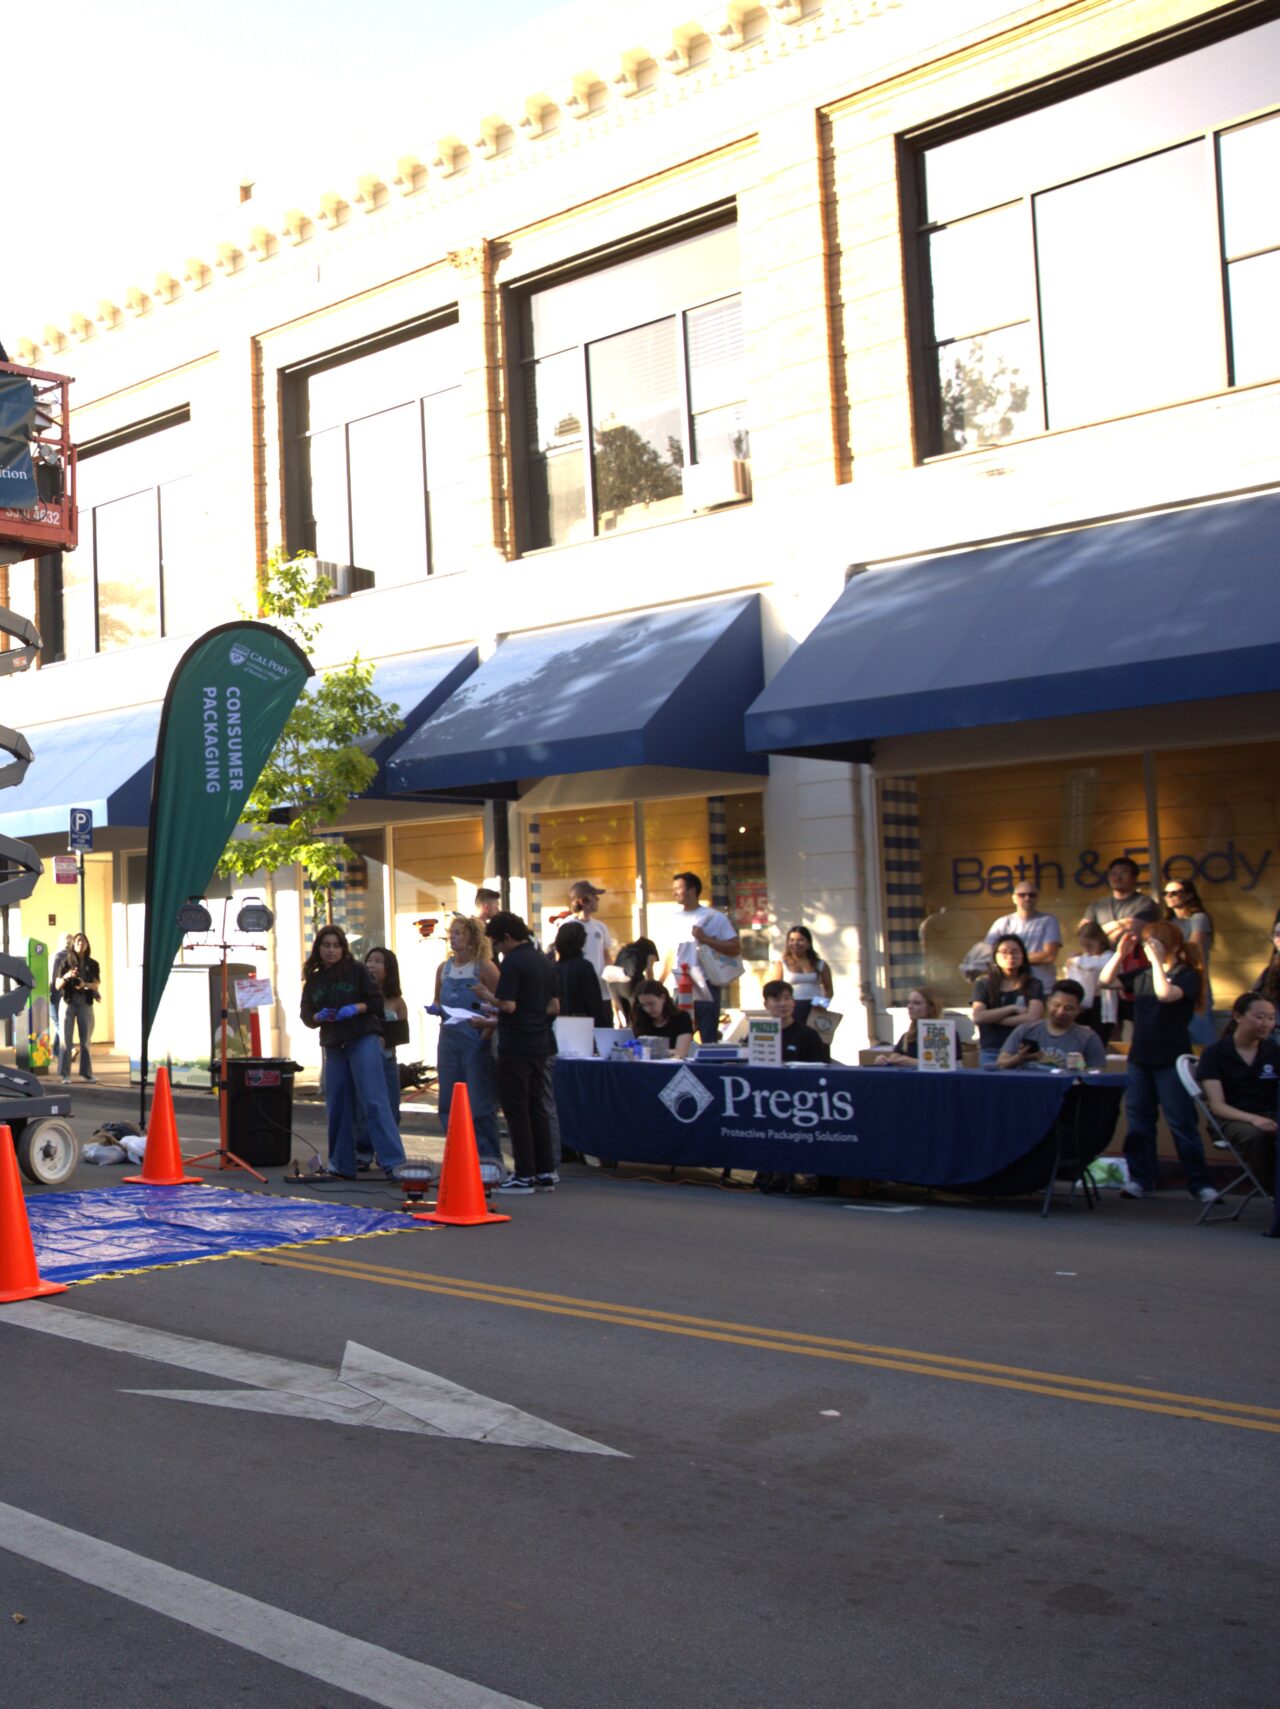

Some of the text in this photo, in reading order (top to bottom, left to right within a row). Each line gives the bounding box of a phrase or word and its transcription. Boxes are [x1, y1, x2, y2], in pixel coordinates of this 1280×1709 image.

[250, 651, 291, 676] CAL POLY
[203, 686, 220, 793] PACKAGING
[226, 686, 244, 791] CONSUMER
[75, 813, 87, 831] P
[951, 853, 1065, 896] Bath
[1073, 849, 1112, 889] &
[719, 1076, 855, 1127] Pregis
[720, 1127, 859, 1143] Protective Packaging Solutions
